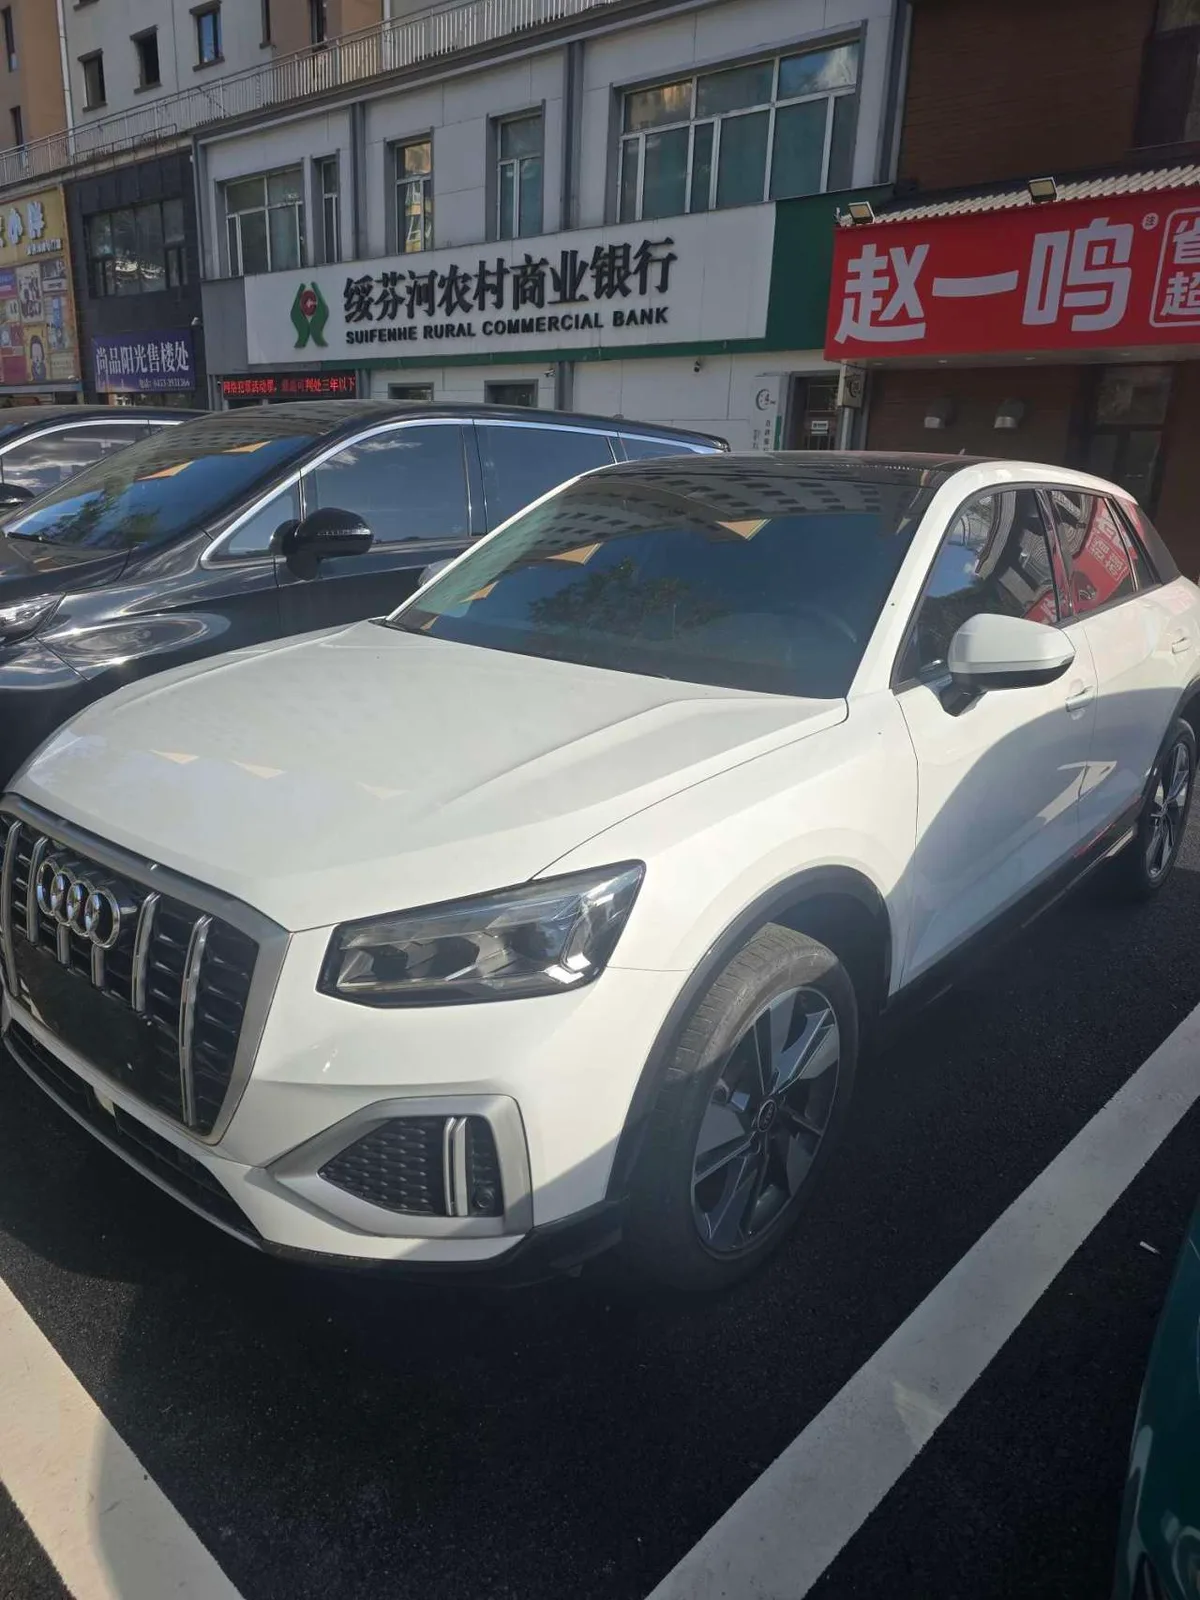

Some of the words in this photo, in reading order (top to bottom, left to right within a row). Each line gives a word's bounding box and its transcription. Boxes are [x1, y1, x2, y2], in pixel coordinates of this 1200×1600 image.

[343, 236, 678, 323] 绥芬河农村商业银行
[834, 217, 1134, 344] 赵一鸣
[345, 325, 418, 345] SUIFENHE
[423, 319, 476, 340] RURAL
[482, 311, 604, 336] COMMERCIAL
[612, 305, 669, 328] BANK
[96, 341, 190, 375] 尚品阳光售楼处
